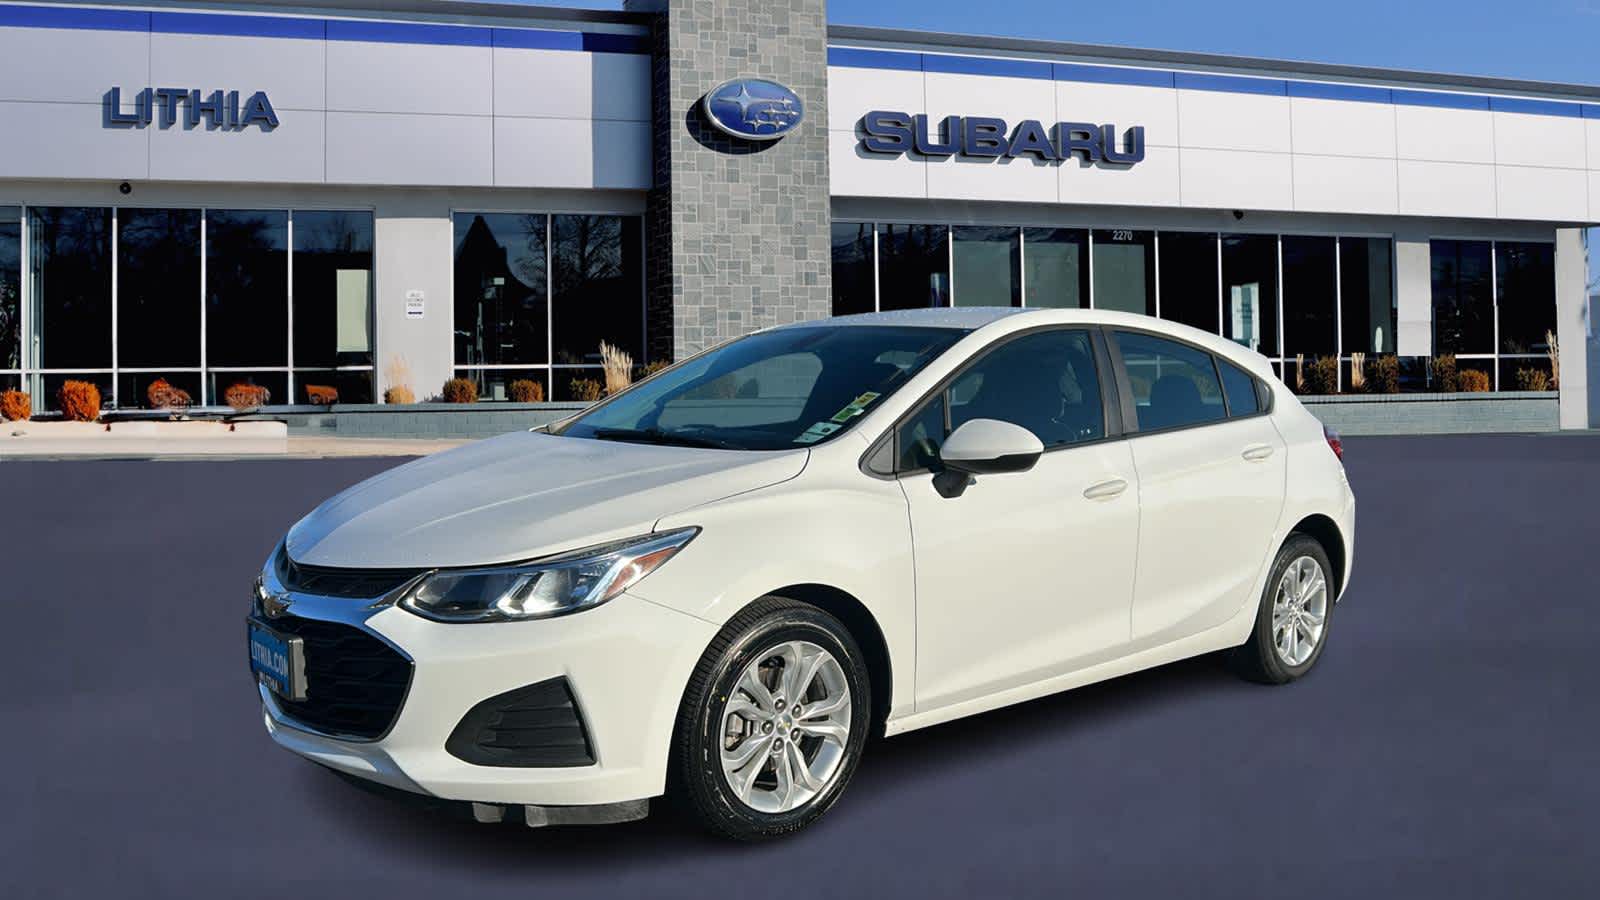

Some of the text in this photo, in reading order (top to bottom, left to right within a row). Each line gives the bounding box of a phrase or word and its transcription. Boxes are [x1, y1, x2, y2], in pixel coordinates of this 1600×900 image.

[104, 86, 280, 131] LITHIA
[858, 110, 1145, 167] SUBARU
[1112, 230, 1133, 241] 2270
